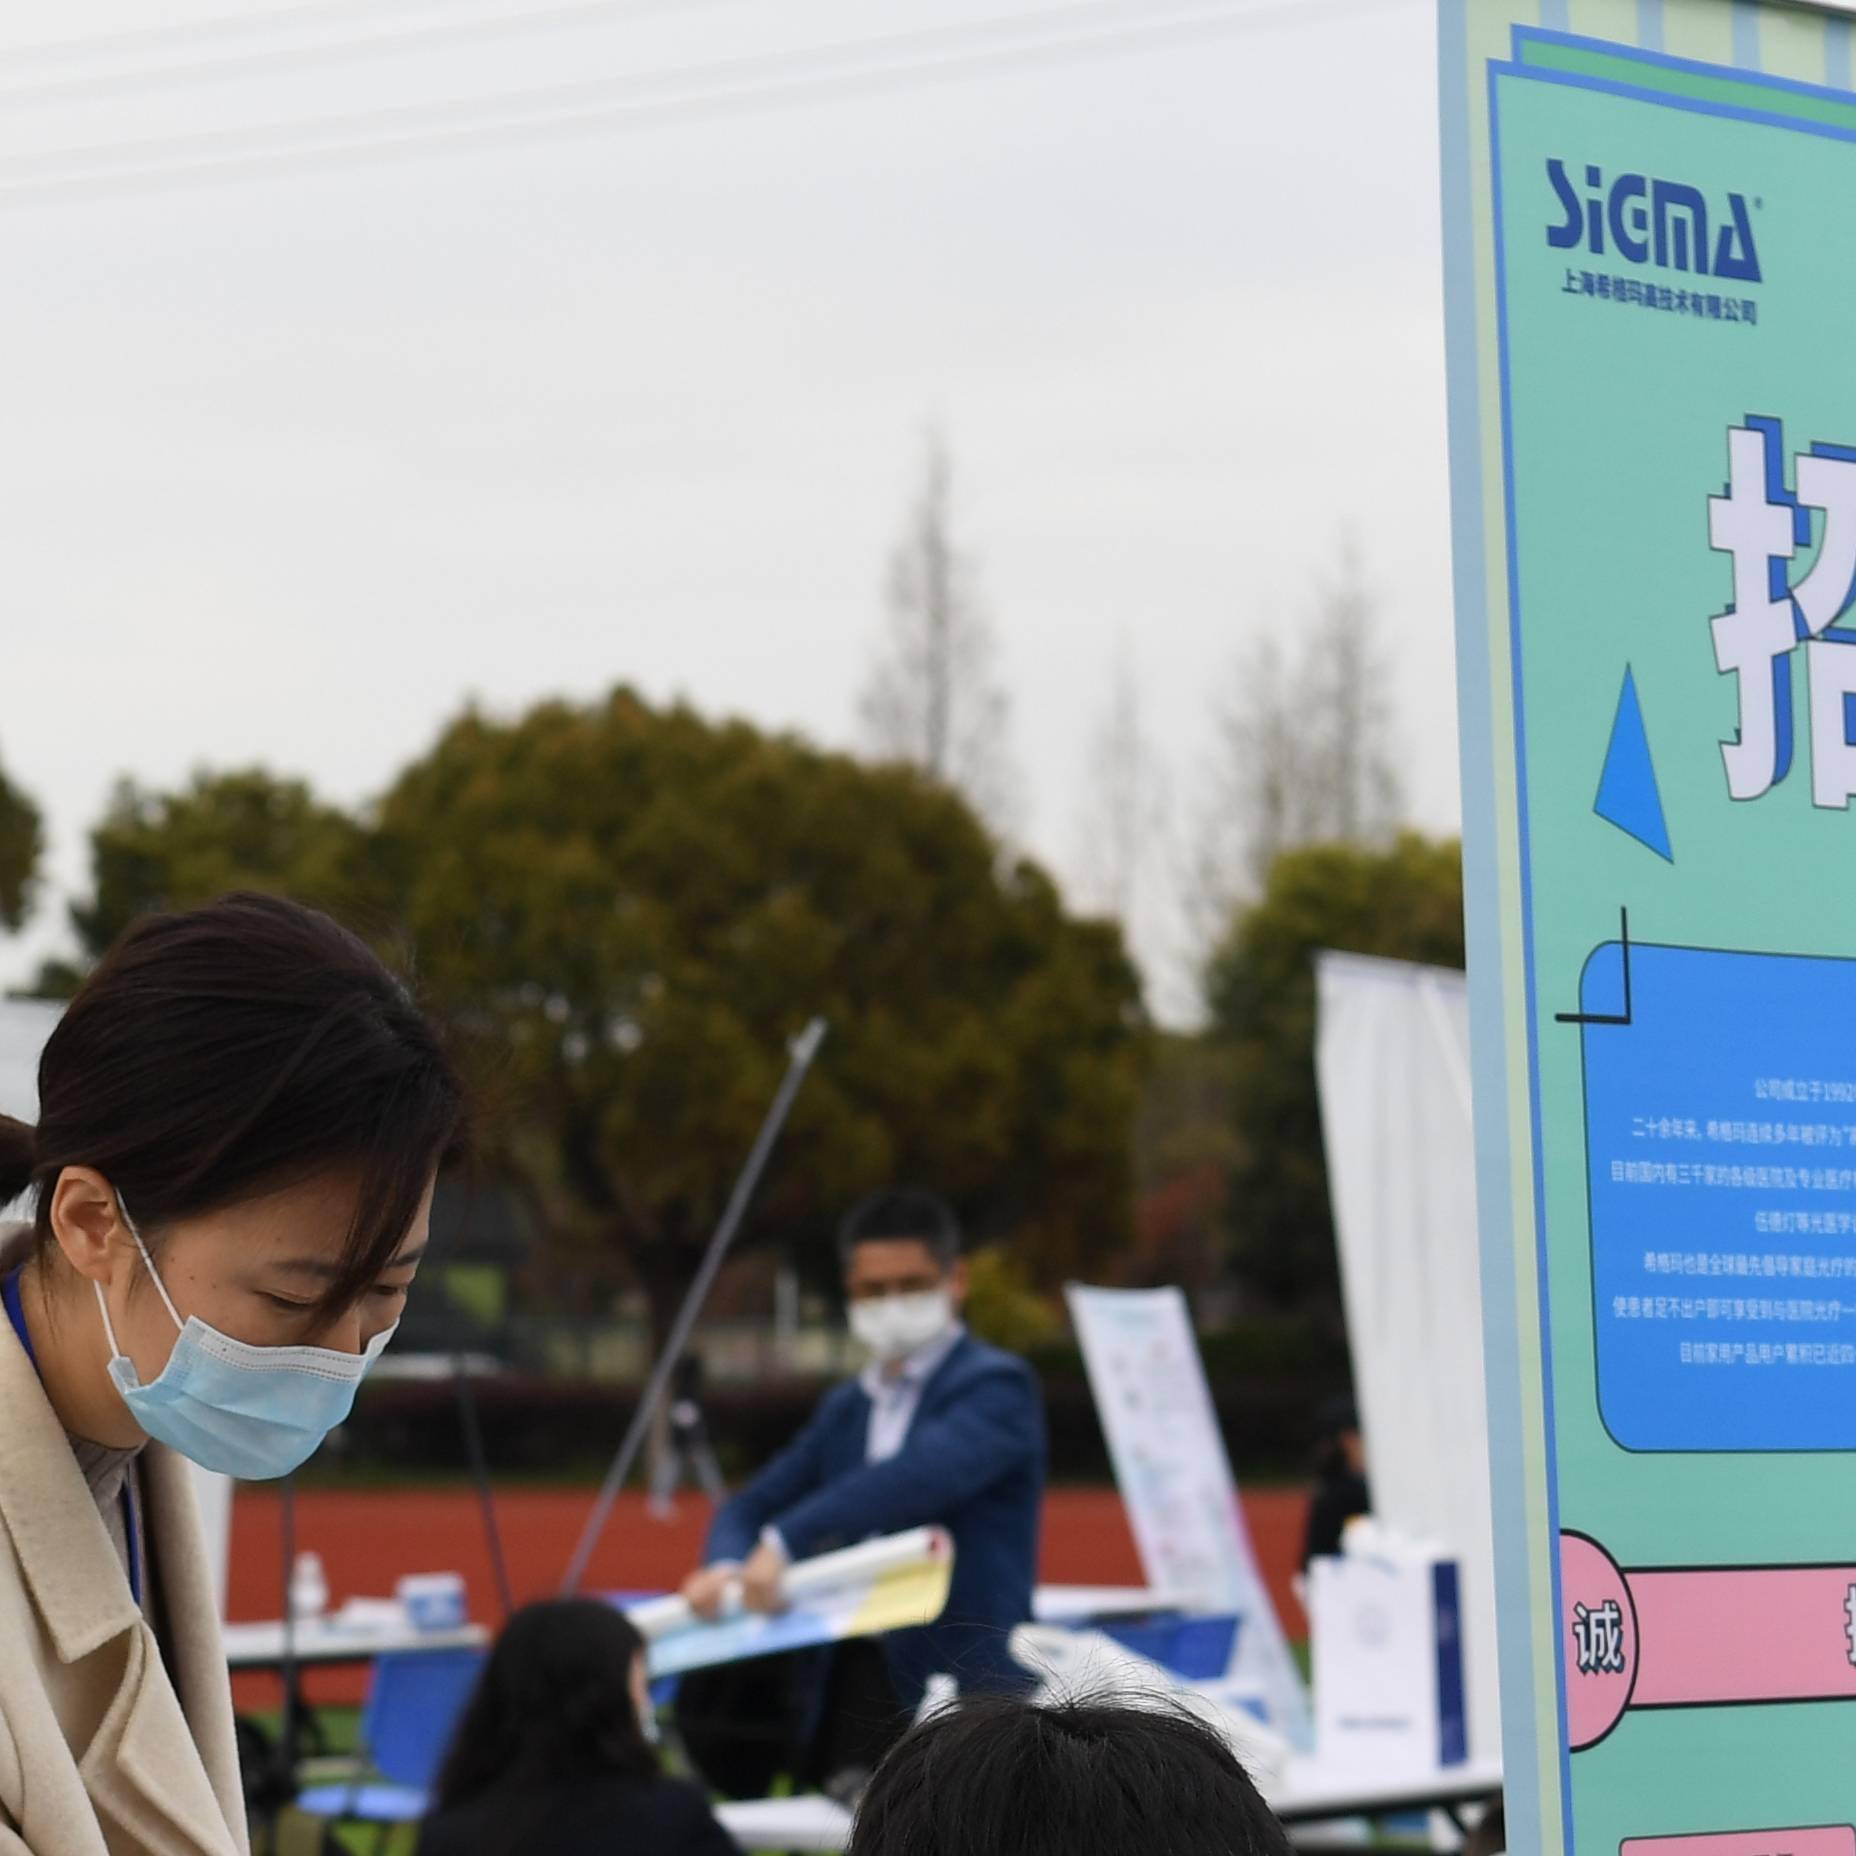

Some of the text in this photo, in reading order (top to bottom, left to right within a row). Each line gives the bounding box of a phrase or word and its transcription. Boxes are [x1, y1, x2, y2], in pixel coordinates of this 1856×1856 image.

[1561, 268, 1757, 326] 上海希格玛高技术有限公司
[1572, 1600, 1626, 1674] 诚
